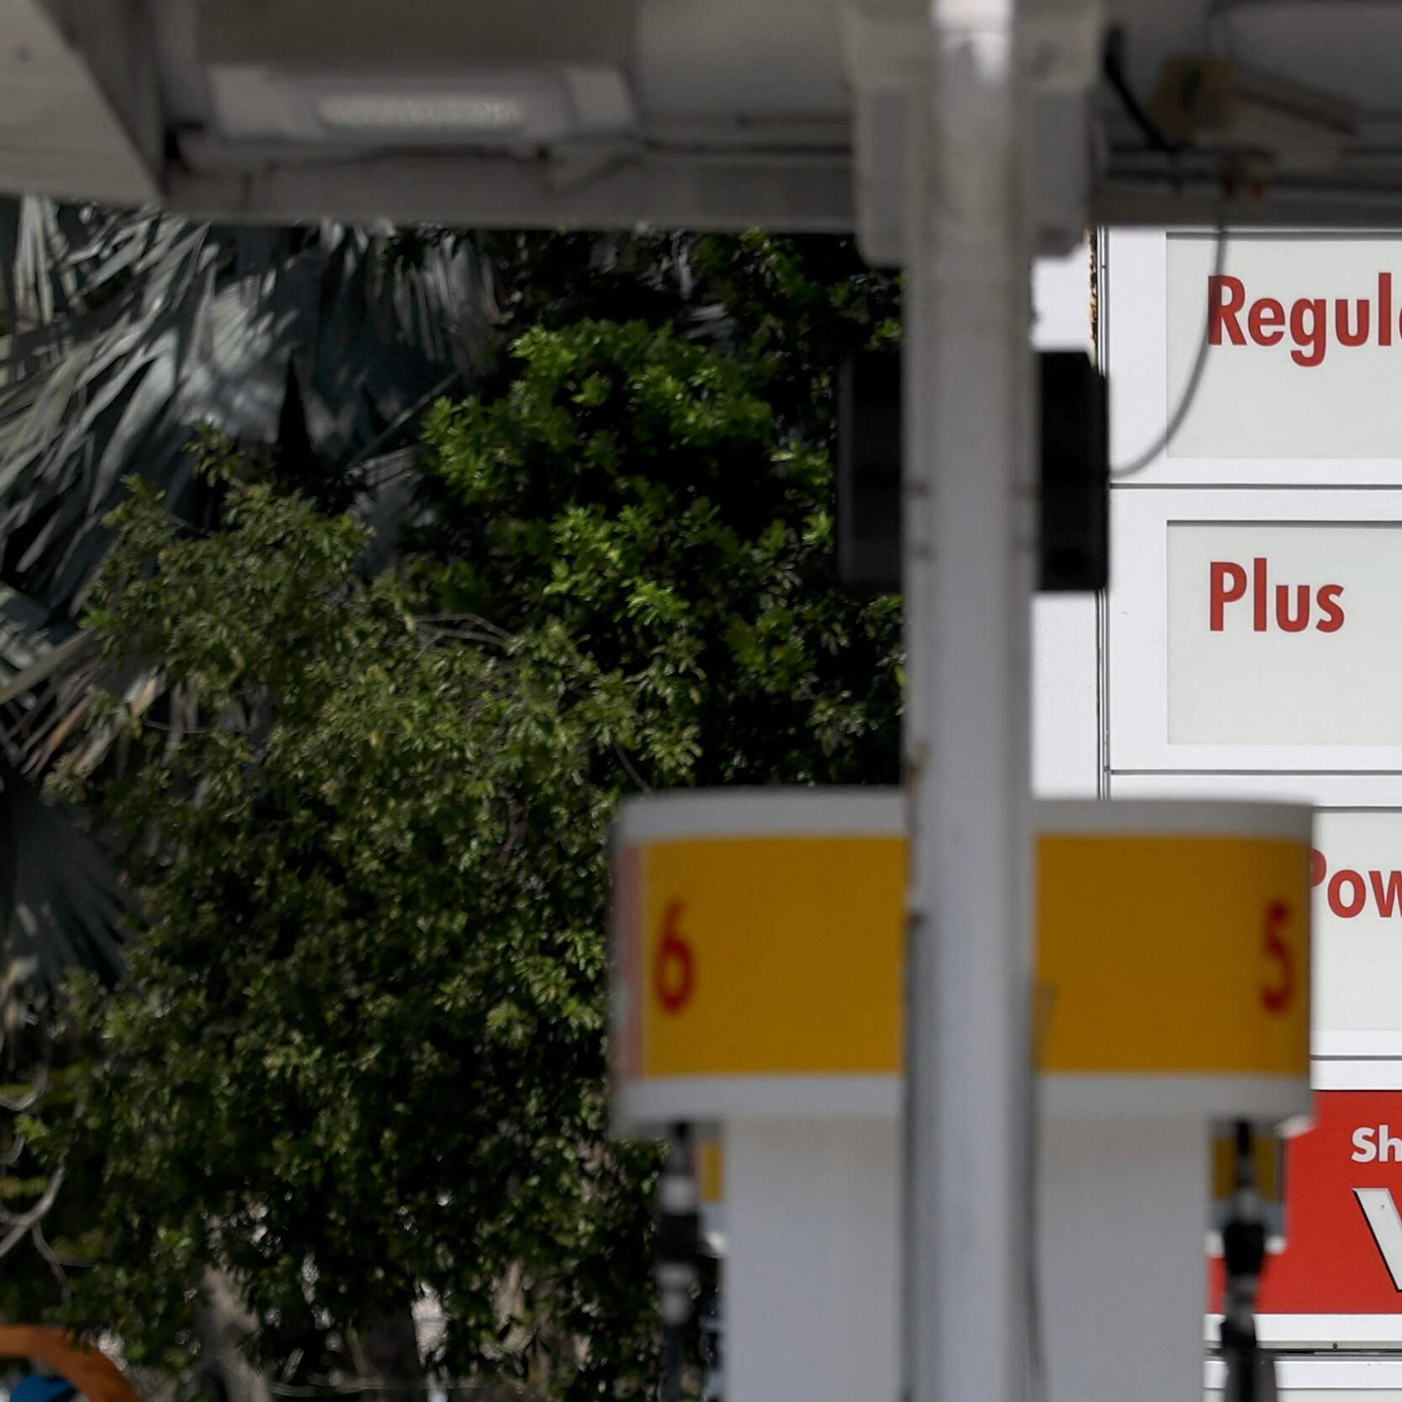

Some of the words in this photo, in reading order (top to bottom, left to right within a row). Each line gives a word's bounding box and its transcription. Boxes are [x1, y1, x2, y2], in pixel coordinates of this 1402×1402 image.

[1210, 556, 1345, 634] Plus
[653, 903, 696, 1015] 6
[1257, 898, 1299, 1015] 5
